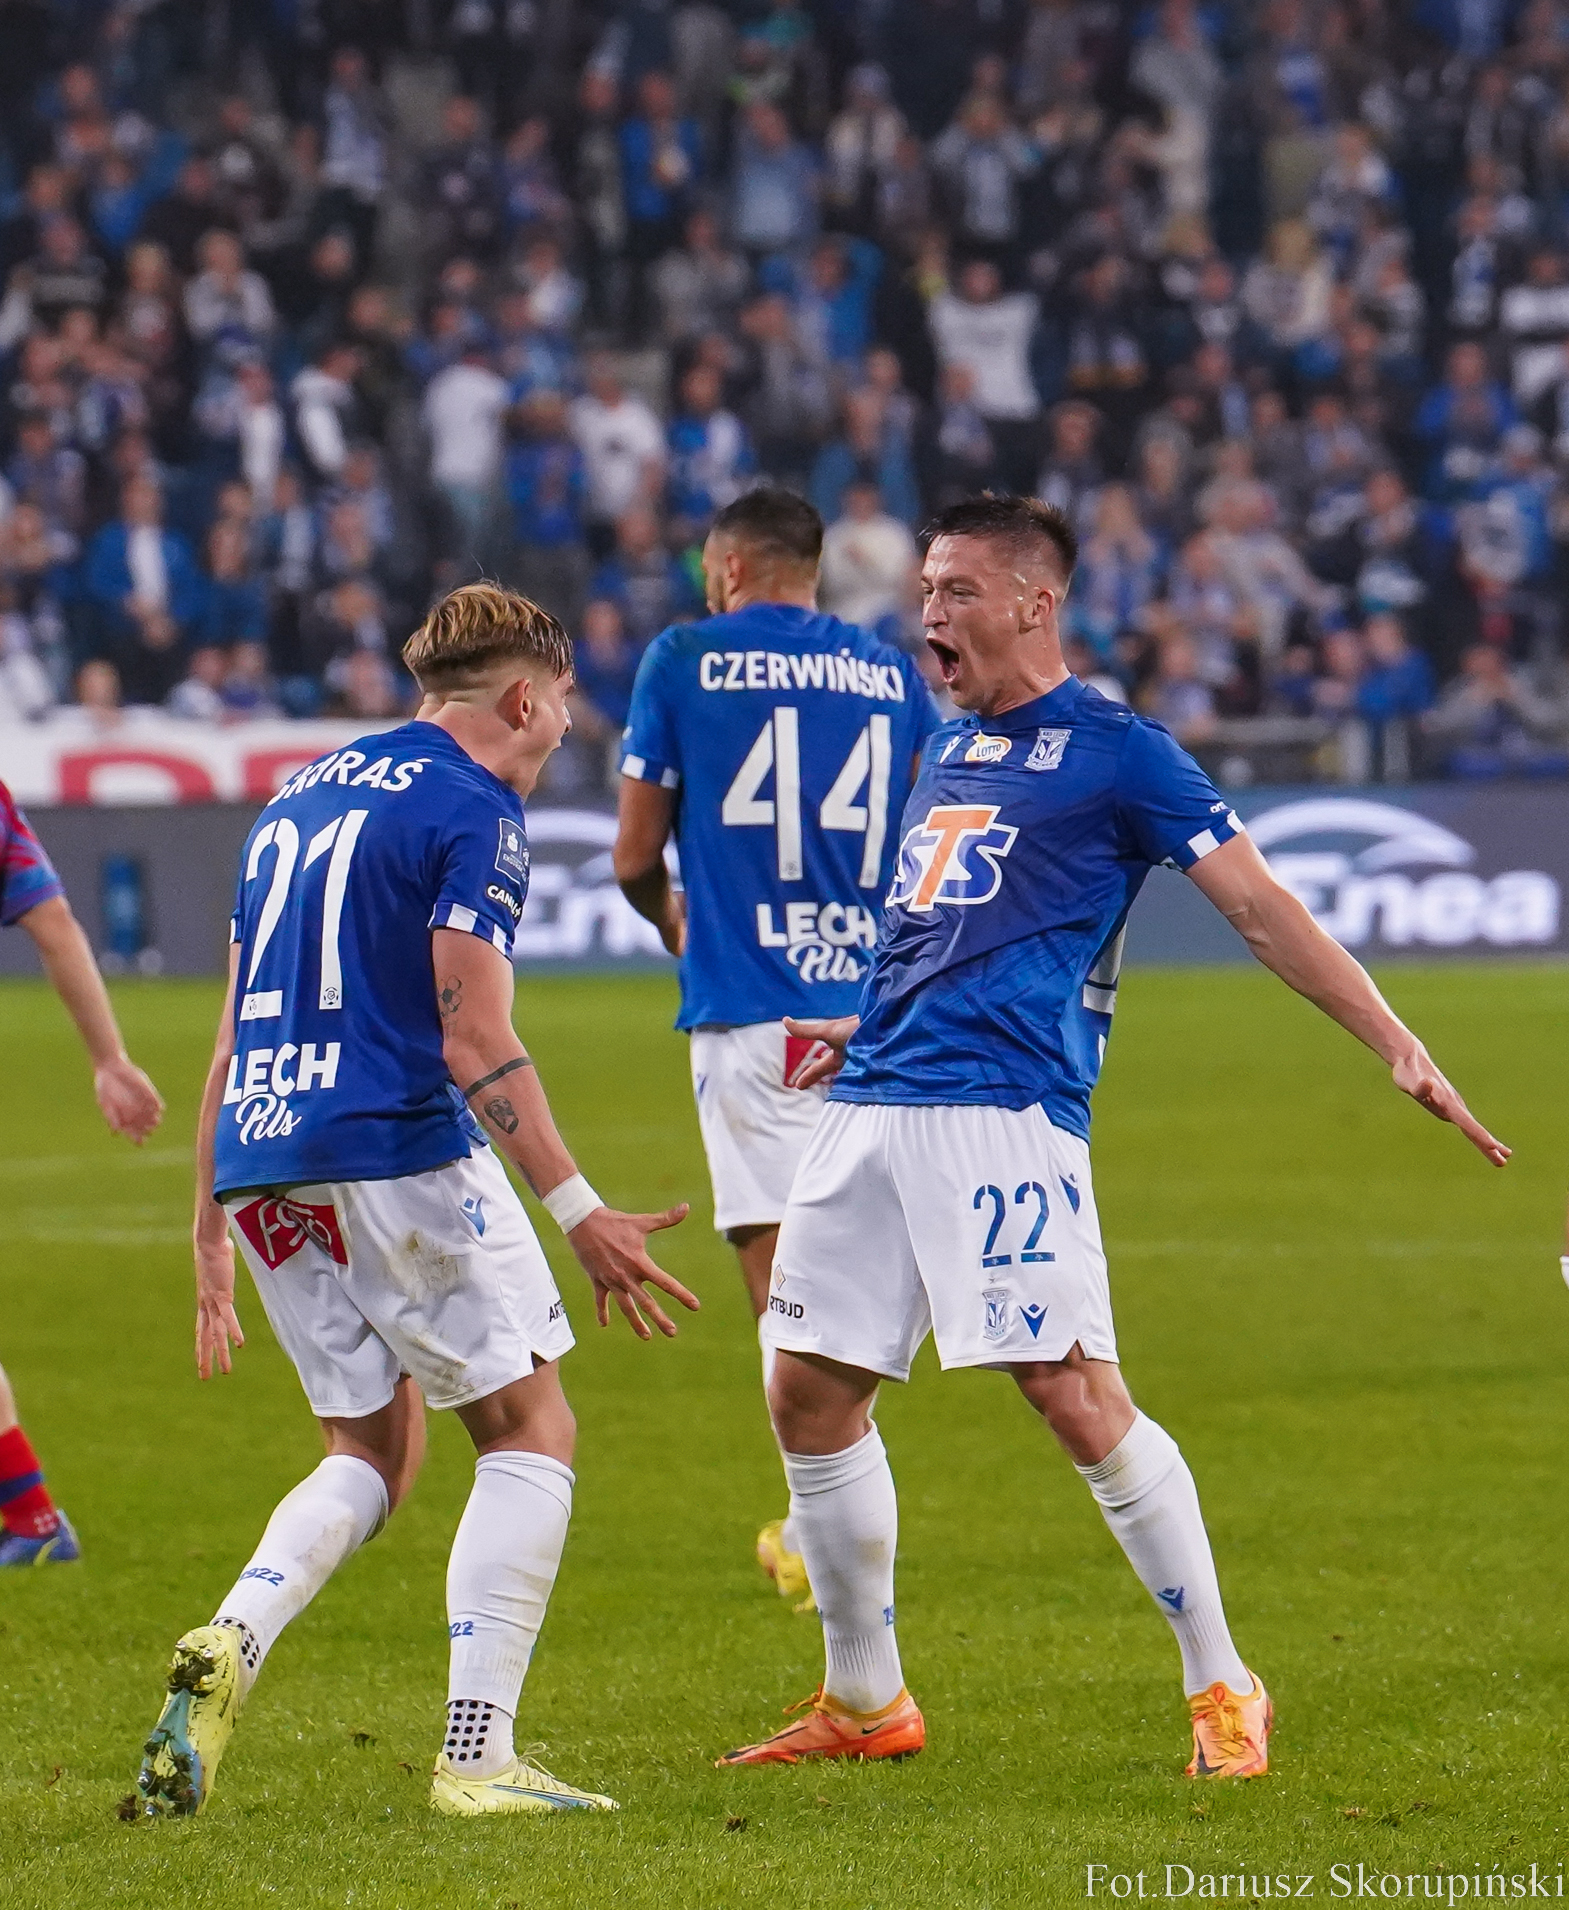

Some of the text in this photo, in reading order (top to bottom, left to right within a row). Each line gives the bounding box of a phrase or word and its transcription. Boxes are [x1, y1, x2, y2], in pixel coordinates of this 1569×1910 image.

[700, 648, 905, 702] CZERWIŃSKI
[976, 743, 1002, 758] LOTTO
[721, 706, 892, 889] 44
[885, 804, 1020, 912] STS
[239, 809, 369, 1021] 21
[756, 901, 877, 949] LECH
[786, 940, 869, 985] Pils
[222, 1042, 341, 1105] LECH
[235, 1093, 303, 1145] Pils
[973, 1180, 1057, 1268] 22
